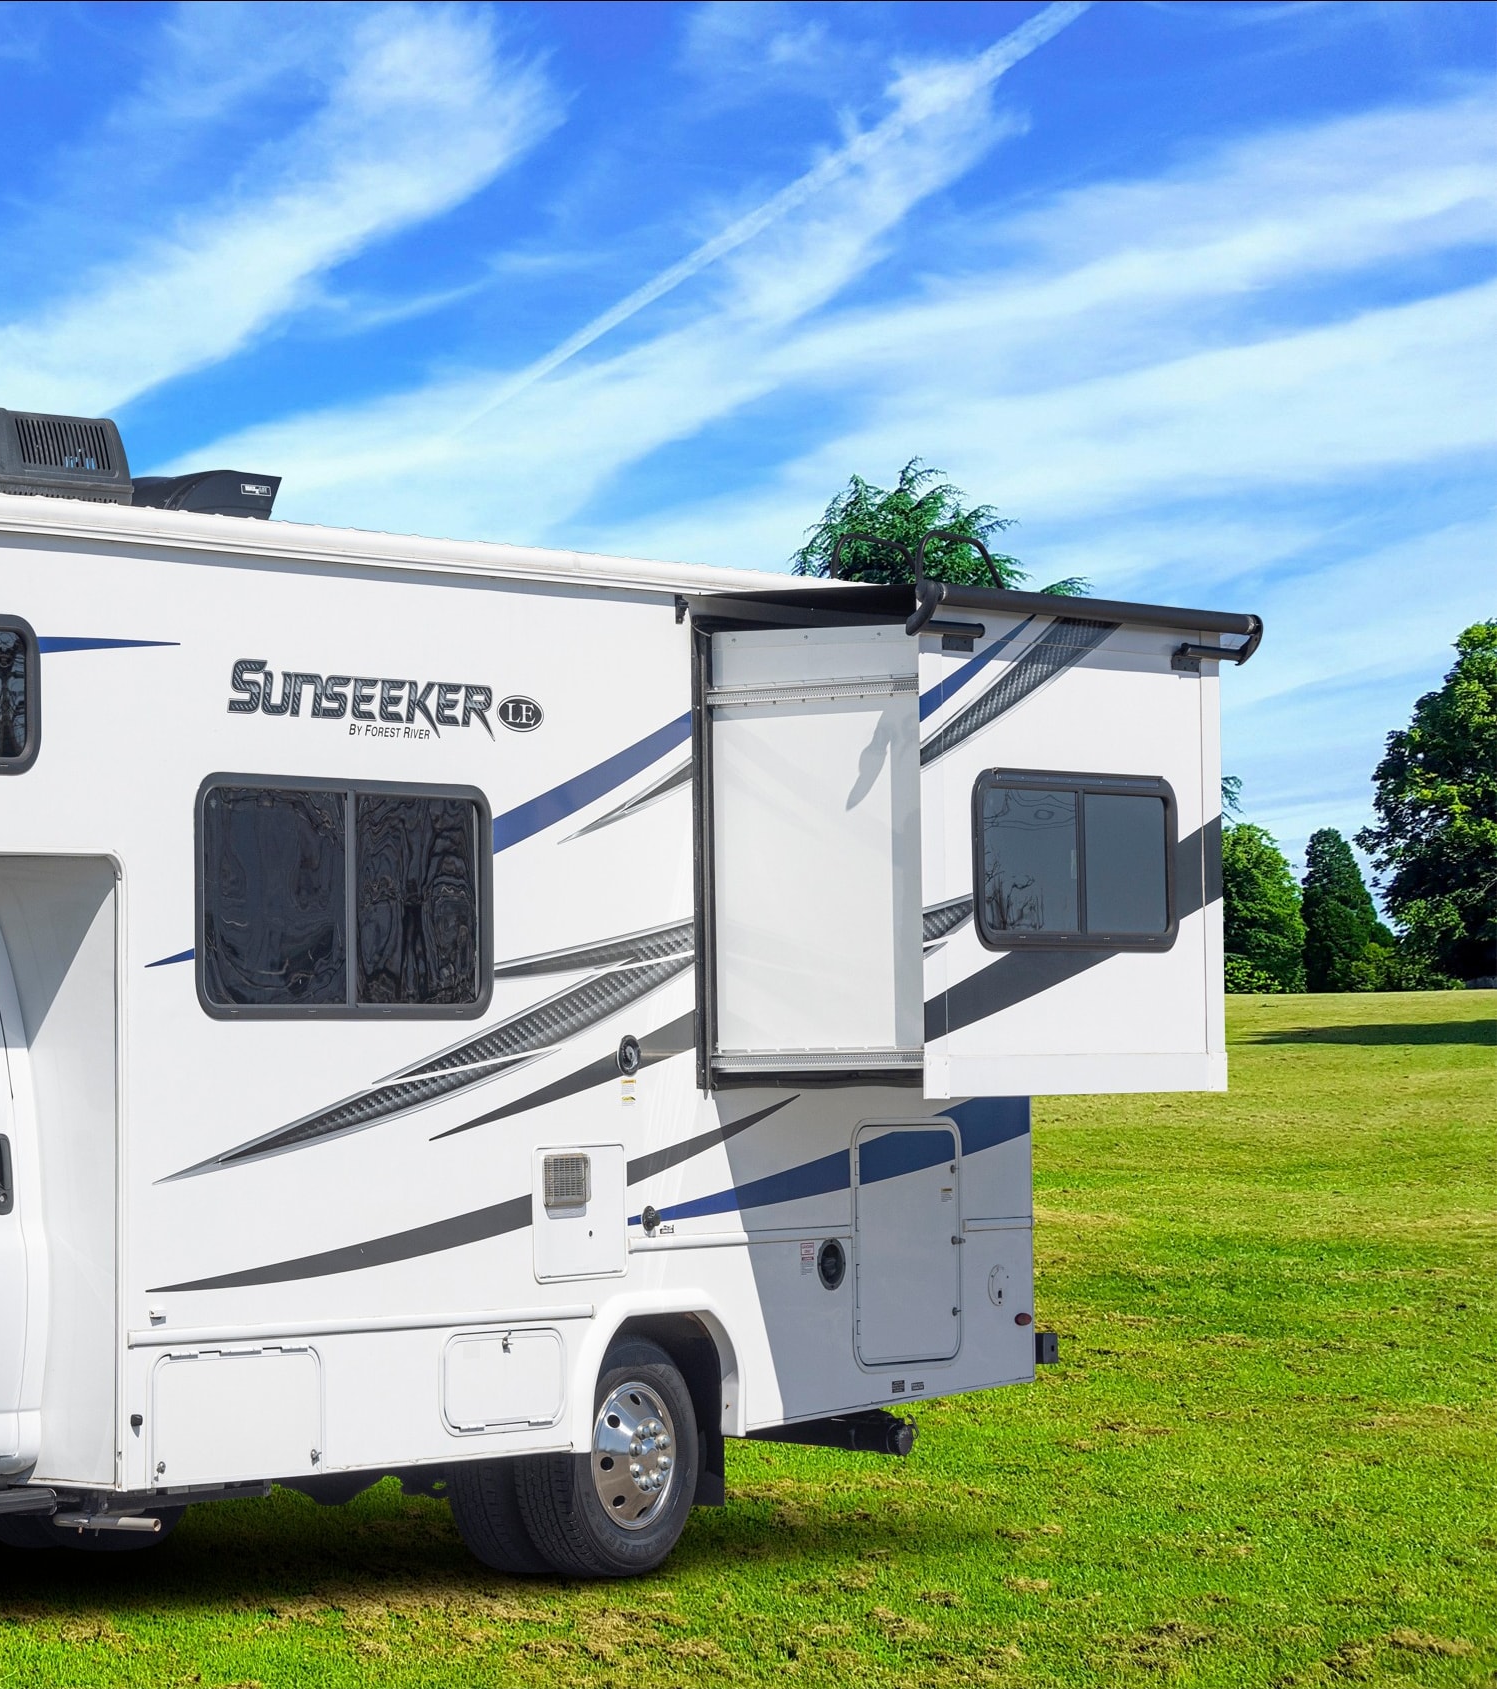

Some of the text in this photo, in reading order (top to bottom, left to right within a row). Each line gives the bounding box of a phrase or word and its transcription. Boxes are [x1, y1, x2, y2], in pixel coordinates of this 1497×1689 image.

[227, 657, 496, 742] SUNSEEKER
[505, 702, 537, 728] LE
[364, 724, 401, 738] FOREST
[403, 726, 431, 740] RIVER
